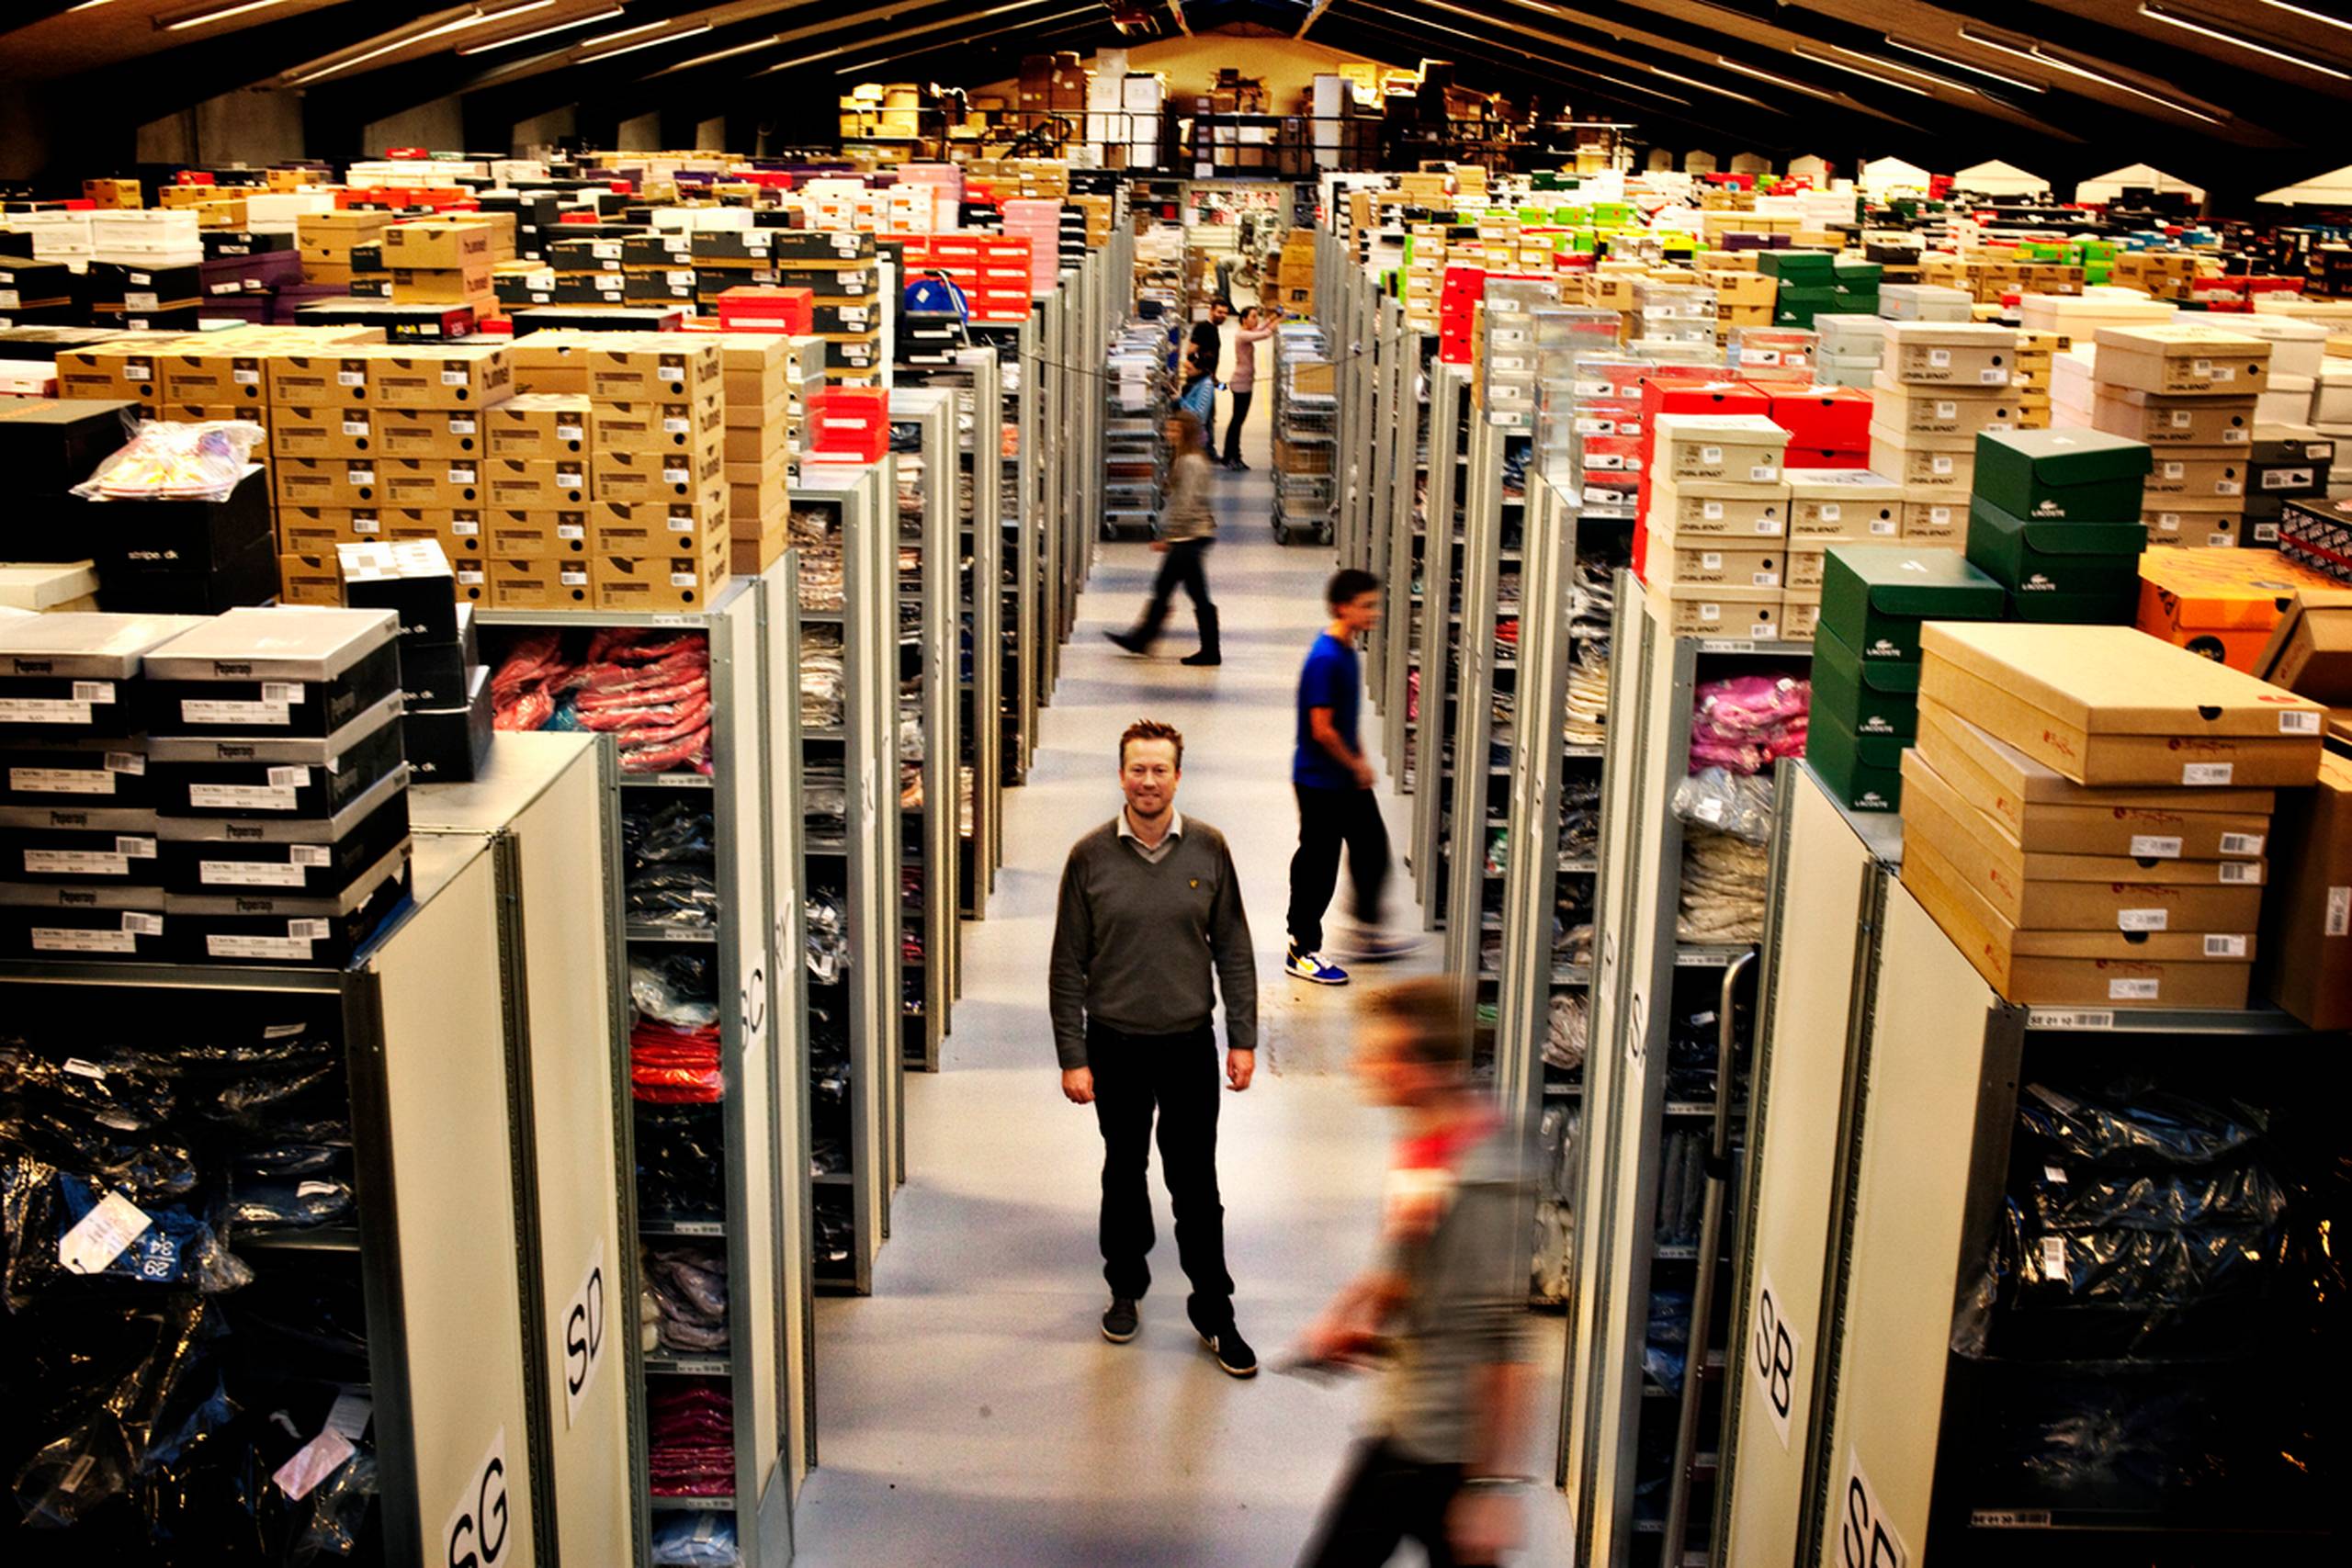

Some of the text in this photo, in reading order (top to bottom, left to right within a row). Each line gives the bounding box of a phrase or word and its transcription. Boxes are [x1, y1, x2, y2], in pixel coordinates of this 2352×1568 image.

[2021, 582, 2055, 591] LACOSTE
[1866, 648, 1901, 657] LACOSTE
[1859, 725, 1894, 733] LACOSTE
[1854, 800, 1888, 808] LACOSTE
[150, 1240, 175, 1256] 34
[143, 1259, 169, 1277] 29
[567, 1267, 603, 1395] SD
[1756, 1289, 1792, 1418] SB
[449, 1457, 508, 1568] SG
